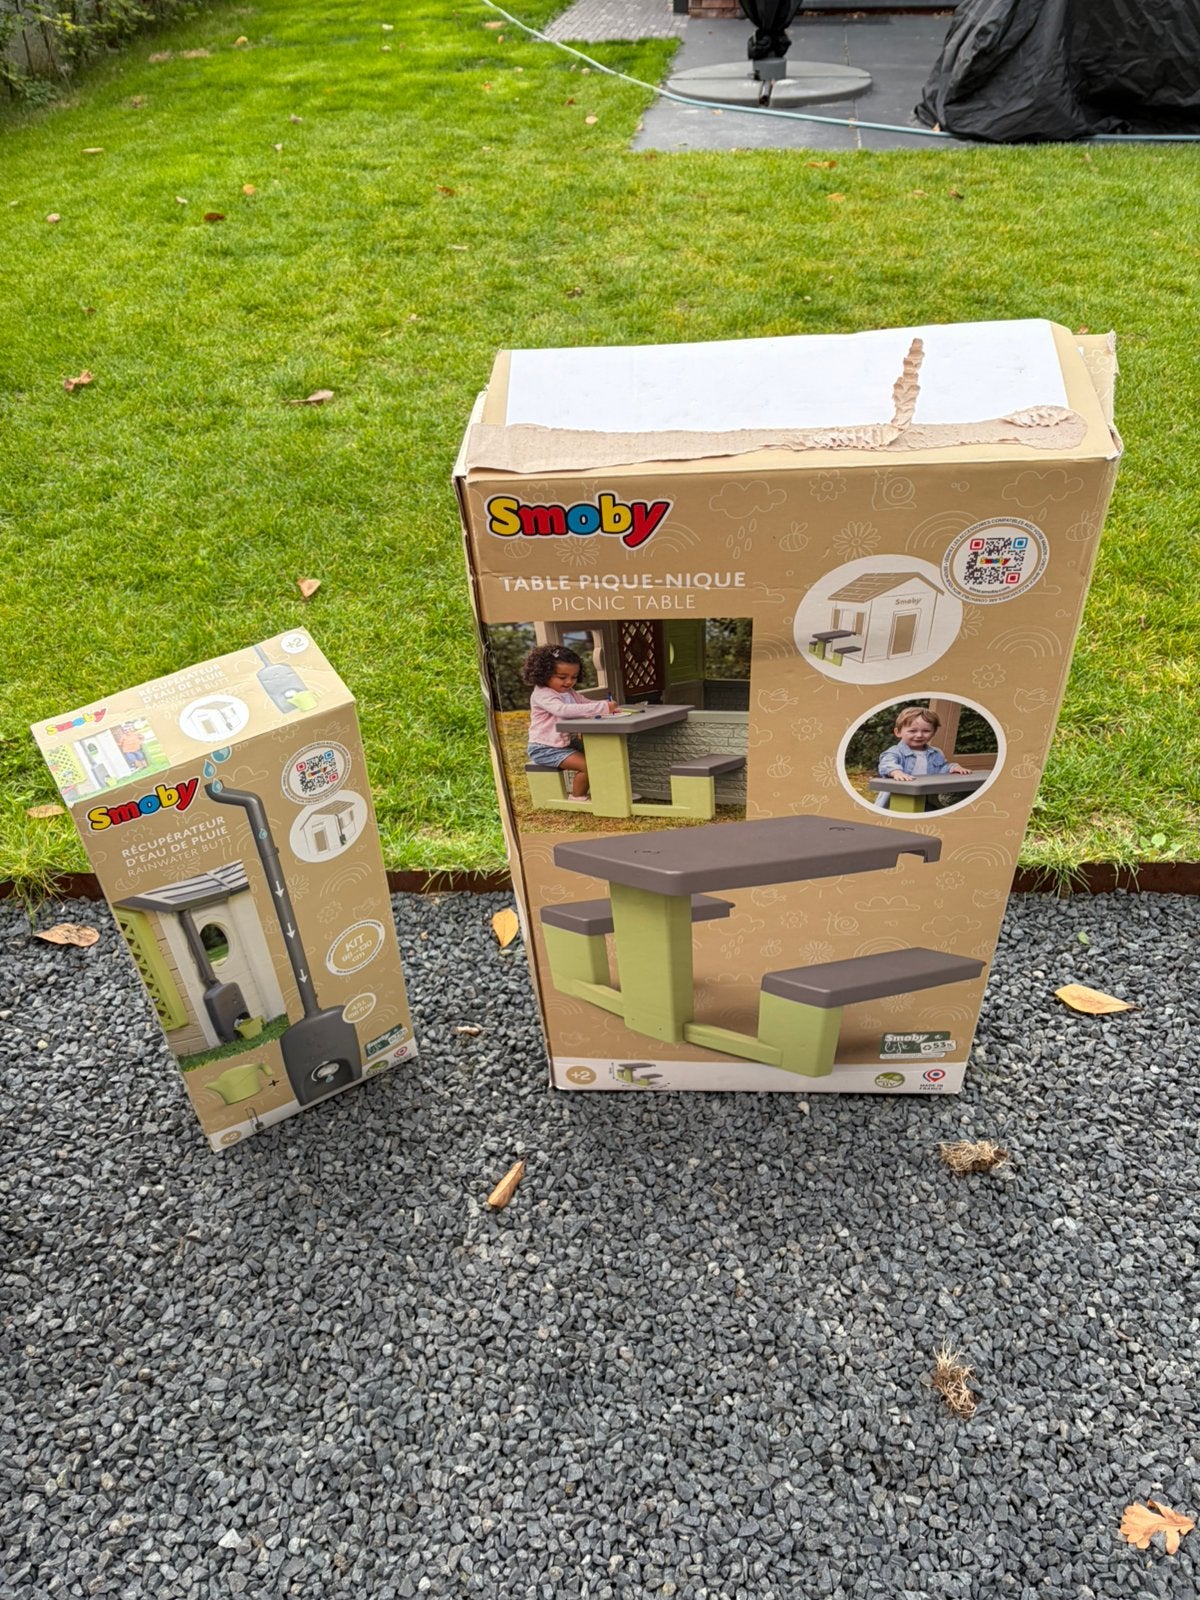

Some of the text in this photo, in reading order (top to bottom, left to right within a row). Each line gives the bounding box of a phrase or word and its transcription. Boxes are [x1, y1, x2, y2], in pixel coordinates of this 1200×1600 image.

[486, 492, 671, 548] Smoby
[500, 572, 746, 592] TABLE PIQUE-NIQUE
[552, 594, 696, 612] PICNIC TABLE
[45, 707, 108, 736] Smoby
[87, 777, 200, 831] Smoby
[121, 815, 226, 859] RÉCUPÉRATEUR
[170, 840, 188, 854] DE
[191, 826, 229, 848] PLUIE
[126, 835, 233, 878] RAINWATER BUTT
[345, 933, 365, 952] KIT
[884, 1033, 929, 1044] Smoby
[571, 1070, 592, 1081] +2
